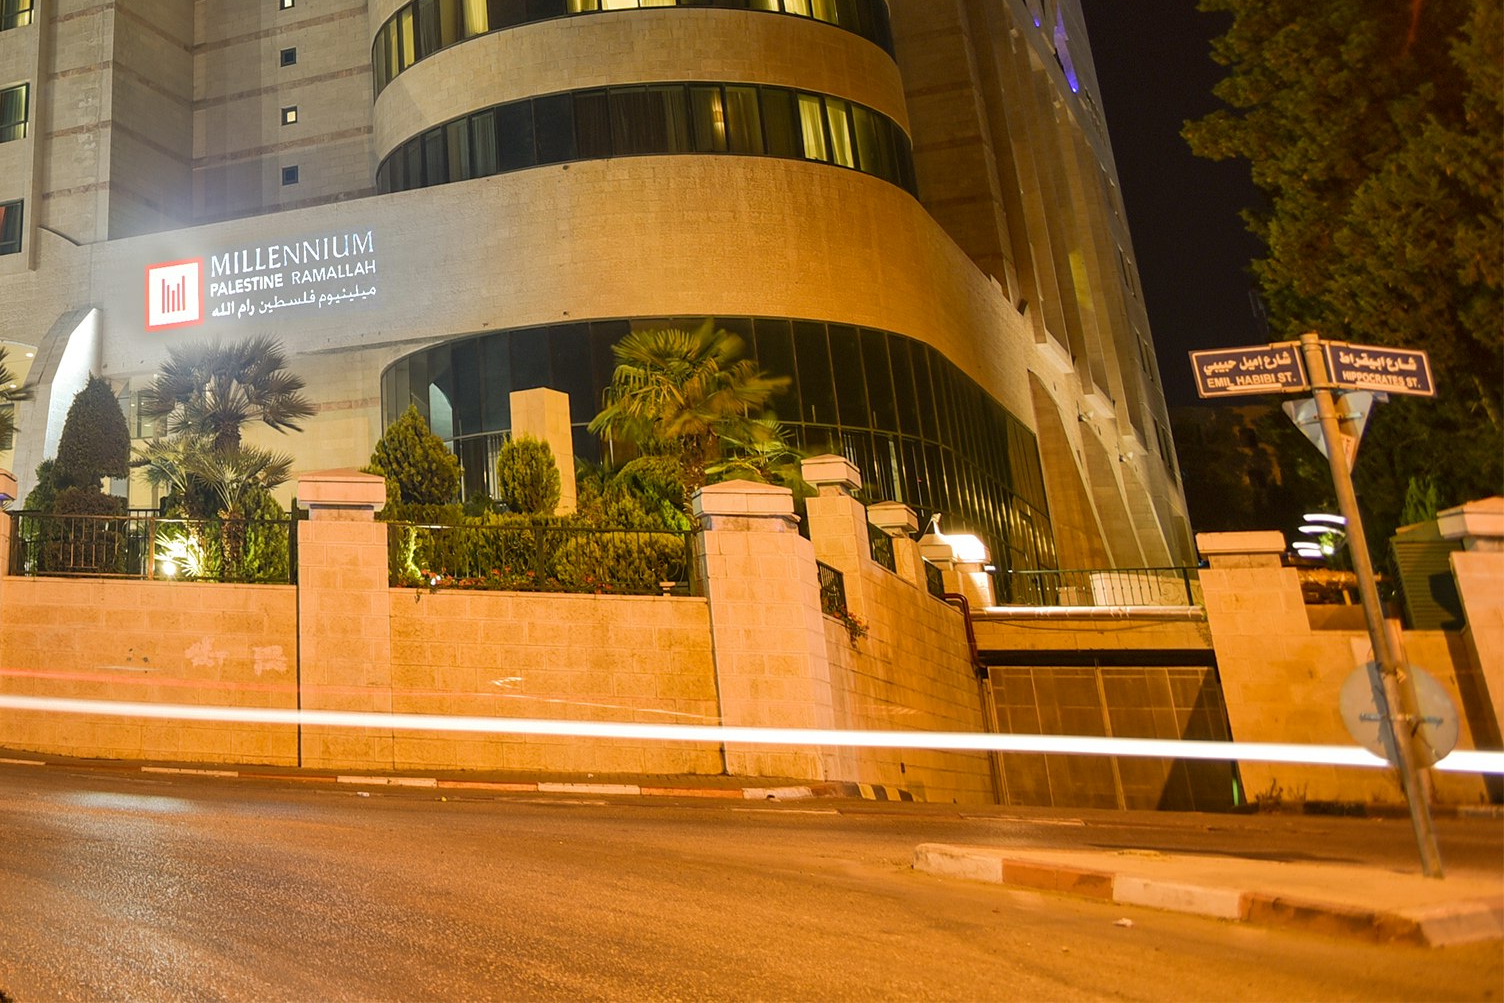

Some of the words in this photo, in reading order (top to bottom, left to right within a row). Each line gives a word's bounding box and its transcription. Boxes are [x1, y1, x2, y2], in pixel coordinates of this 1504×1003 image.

[210, 230, 374, 278] MILLENNIUM
[210, 273, 284, 297] PALESTINE
[291, 260, 377, 285] RAMALLAH
[258, 289, 316, 315] فلسطين
[318, 284, 377, 309] ميلينيوم
[211, 300, 235, 318] الله
[237, 298, 255, 319] رام
[1203, 359, 1237, 376] حبيبي
[1263, 351, 1292, 370] شارع
[1385, 357, 1417, 372] شارع
[1206, 376, 1235, 388] EMIL
[1235, 373, 1276, 386] HABIBI
[1277, 371, 1297, 383] ST.
[1342, 370, 1405, 387] HIPPOCRATES
[1405, 376, 1421, 388] ST.
